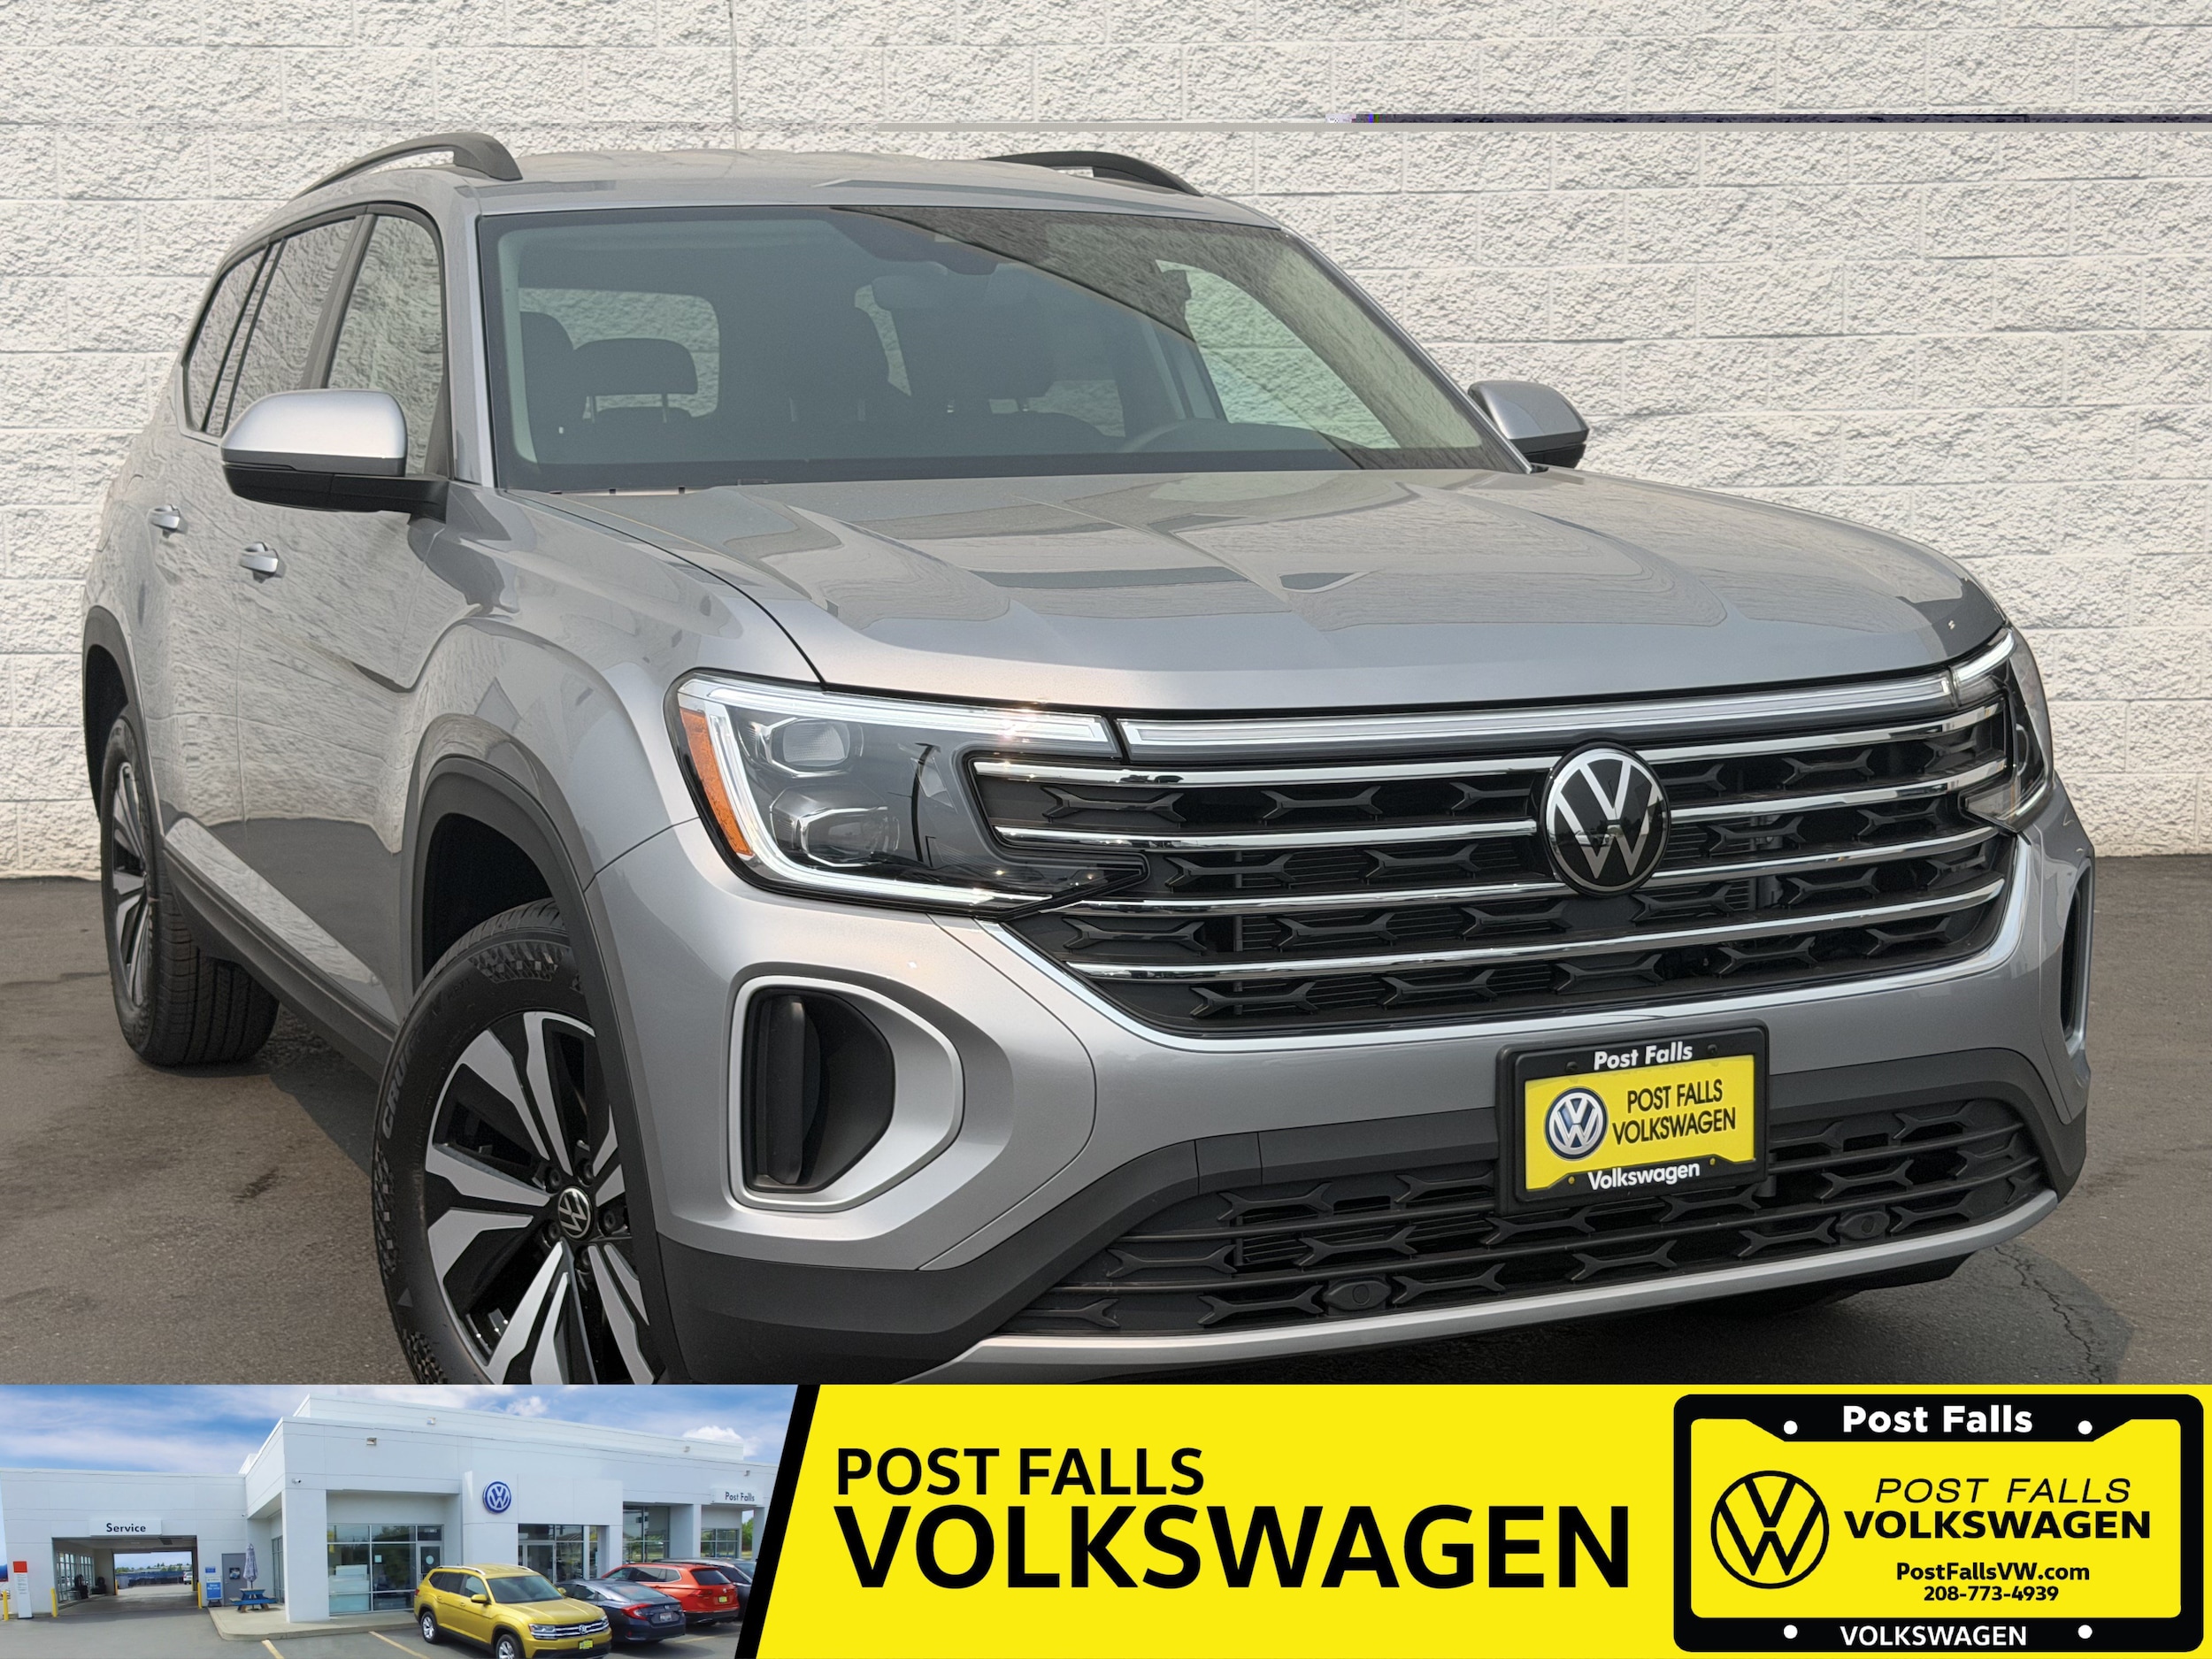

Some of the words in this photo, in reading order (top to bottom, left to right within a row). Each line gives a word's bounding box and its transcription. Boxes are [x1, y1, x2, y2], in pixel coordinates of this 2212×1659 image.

[1594, 1048, 1639, 1071] Post
[1645, 1041, 1693, 1064] Falls
[1627, 1086, 1671, 1114] POST
[1677, 1079, 1723, 1107] FALLS
[1612, 1107, 1736, 1146] VOLKSWAGEN
[1587, 1163, 1701, 1191] Volkswagen
[725, 1491, 740, 1502] Post
[741, 1492, 755, 1502] Falls
[106, 1523, 146, 1532] Service
